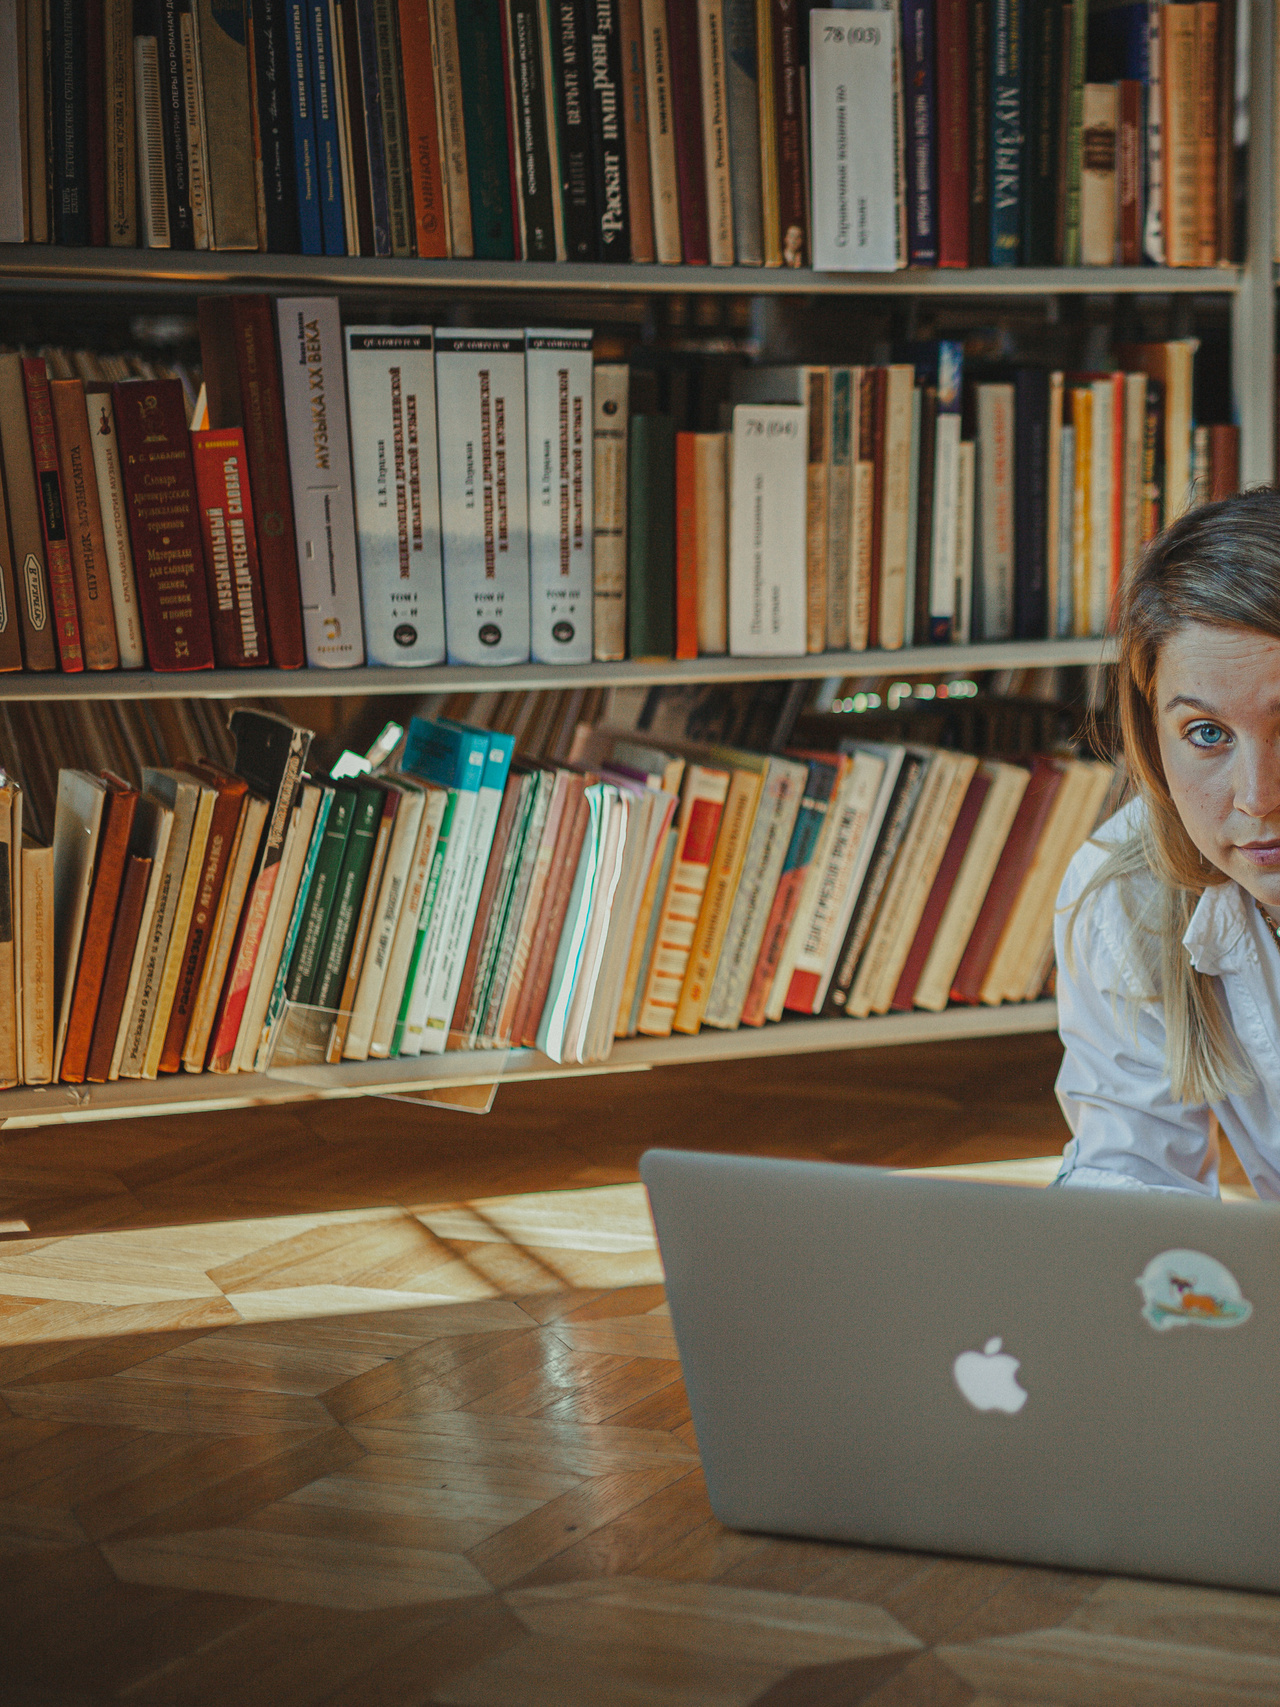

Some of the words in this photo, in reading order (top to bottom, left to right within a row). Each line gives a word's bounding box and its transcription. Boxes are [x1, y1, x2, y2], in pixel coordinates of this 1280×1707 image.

[166, 12, 177, 58] РОМАНАМ
[293, 5, 303, 51] ИЗМЕРЕНЬЯ
[314, 7, 325, 53] ИЗМЕРЕНЬЯ
[517, 12, 527, 60] ИСКУССТВ
[560, 2, 578, 64] МУЗЫКЕ
[824, 26, 845, 43] 78
[848, 27, 881, 47] (03)
[64, 61, 74, 100] СУДЬБЫ
[170, 60, 178, 73] ПО
[296, 53, 304, 78] ИНОГО
[318, 55, 326, 80] ИНОГО
[521, 63, 531, 106] ИСТОРИИ
[170, 76, 180, 108] ОПЕРЫ
[298, 81, 307, 118] ОТЗВУКИ
[320, 82, 329, 119] ОТЗВУКИ
[563, 70, 582, 125] ВЕРЬТЕ
[65, 103, 74, 177] ИСТОРИЧЕСКИЕ
[172, 111, 184, 160] ДИМИТРИН
[524, 116, 534, 151] ТЕОРИИ
[995, 87, 1024, 209] МУЗЫКА
[175, 162, 185, 190] ЮРИЙ
[527, 154, 537, 195] ОСНОВЫ
[601, 150, 624, 244] «Раскат
[306, 319, 322, 362] ВЕКА
[308, 368, 325, 391] XX
[309, 396, 331, 470] МУЗЫКА
[70, 444, 91, 527] МУЗЫКАНТА
[105, 448, 120, 490] МУЗЫКИ
[223, 457, 243, 514] СЛОВАРЬ
[110, 491, 125, 538] ИСТОРИЯ
[28, 567, 37, 576] Я
[82, 533, 99, 600] СПУТНИК
[117, 539, 131, 603] КРАТЧАЙШАЯ
[205, 507, 235, 610] МУЗЫКАЛЬНЫЙ
[29, 584, 42, 621] МУЗЫКА
[228, 519, 259, 658] ЭНЦИКЛОПЕДИЧЕСКИЙ
[200, 833, 224, 908] музыке
[34, 867, 46, 941] ДЕЯТЕЛЬНОСТЬ
[152, 873, 172, 944] музыкантах
[197, 913, 206, 924] о
[151, 945, 157, 953] и
[178, 929, 204, 1015] Рассказы
[34, 944, 45, 1004] ТВОРЧЕСКАЯ
[142, 956, 157, 998] музыке
[131, 1009, 148, 1059] Рассказы
